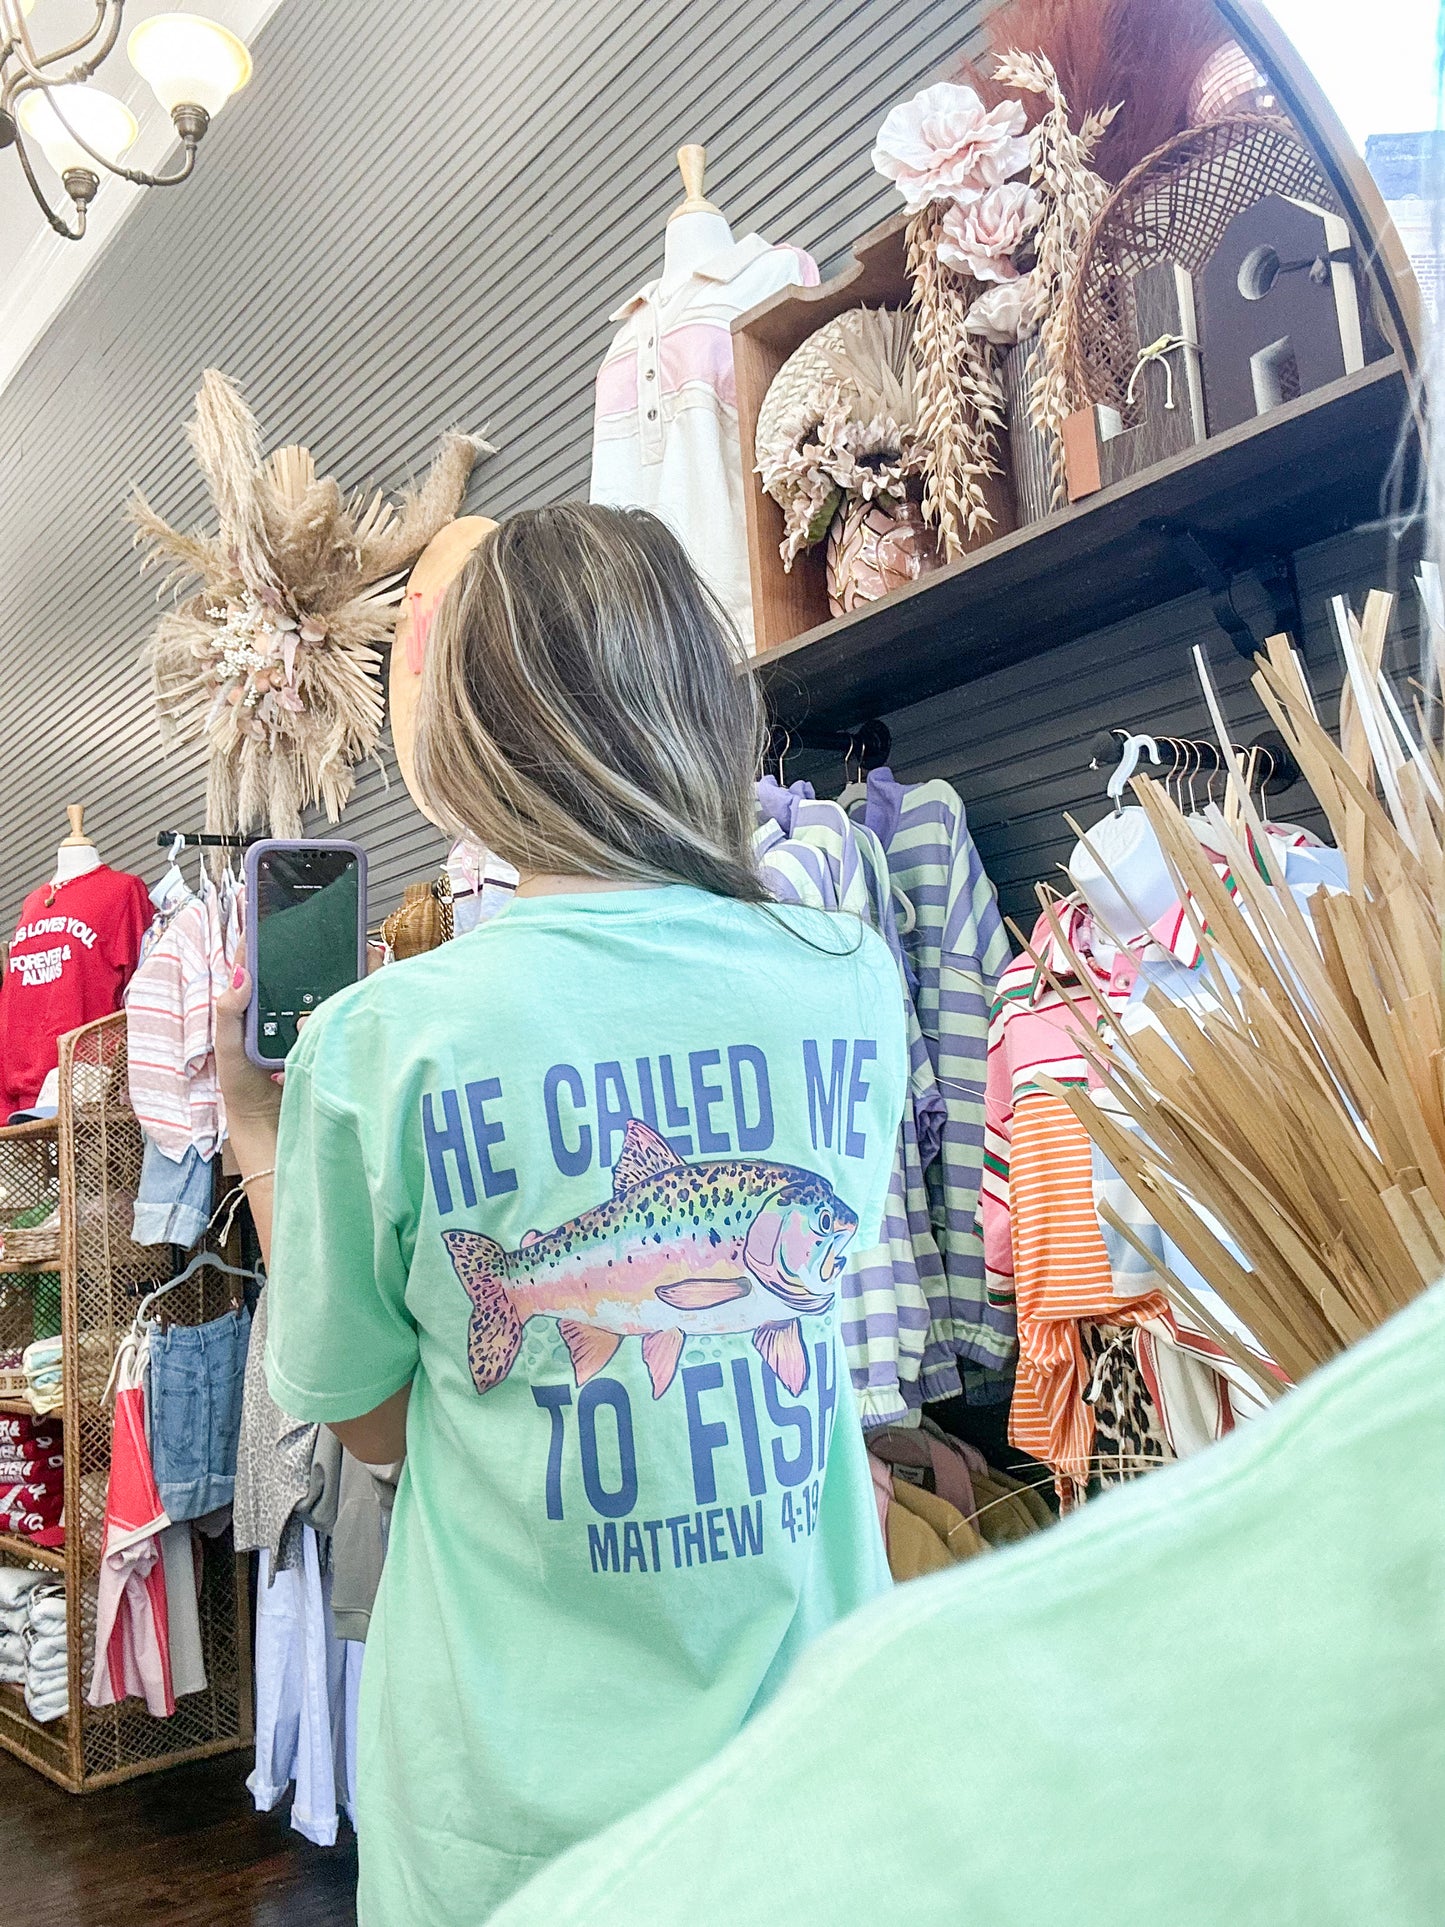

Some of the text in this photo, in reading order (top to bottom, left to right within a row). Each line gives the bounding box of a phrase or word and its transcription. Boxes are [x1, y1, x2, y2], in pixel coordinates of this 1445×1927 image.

[10, 944, 72, 973] FOREVER &
[27, 916, 67, 938] LOVES
[422, 1039, 877, 1215] HE CALLED ME
[531, 1338, 837, 1520] TO FISH
[588, 1479, 819, 1573] MATTHEW 4:19
